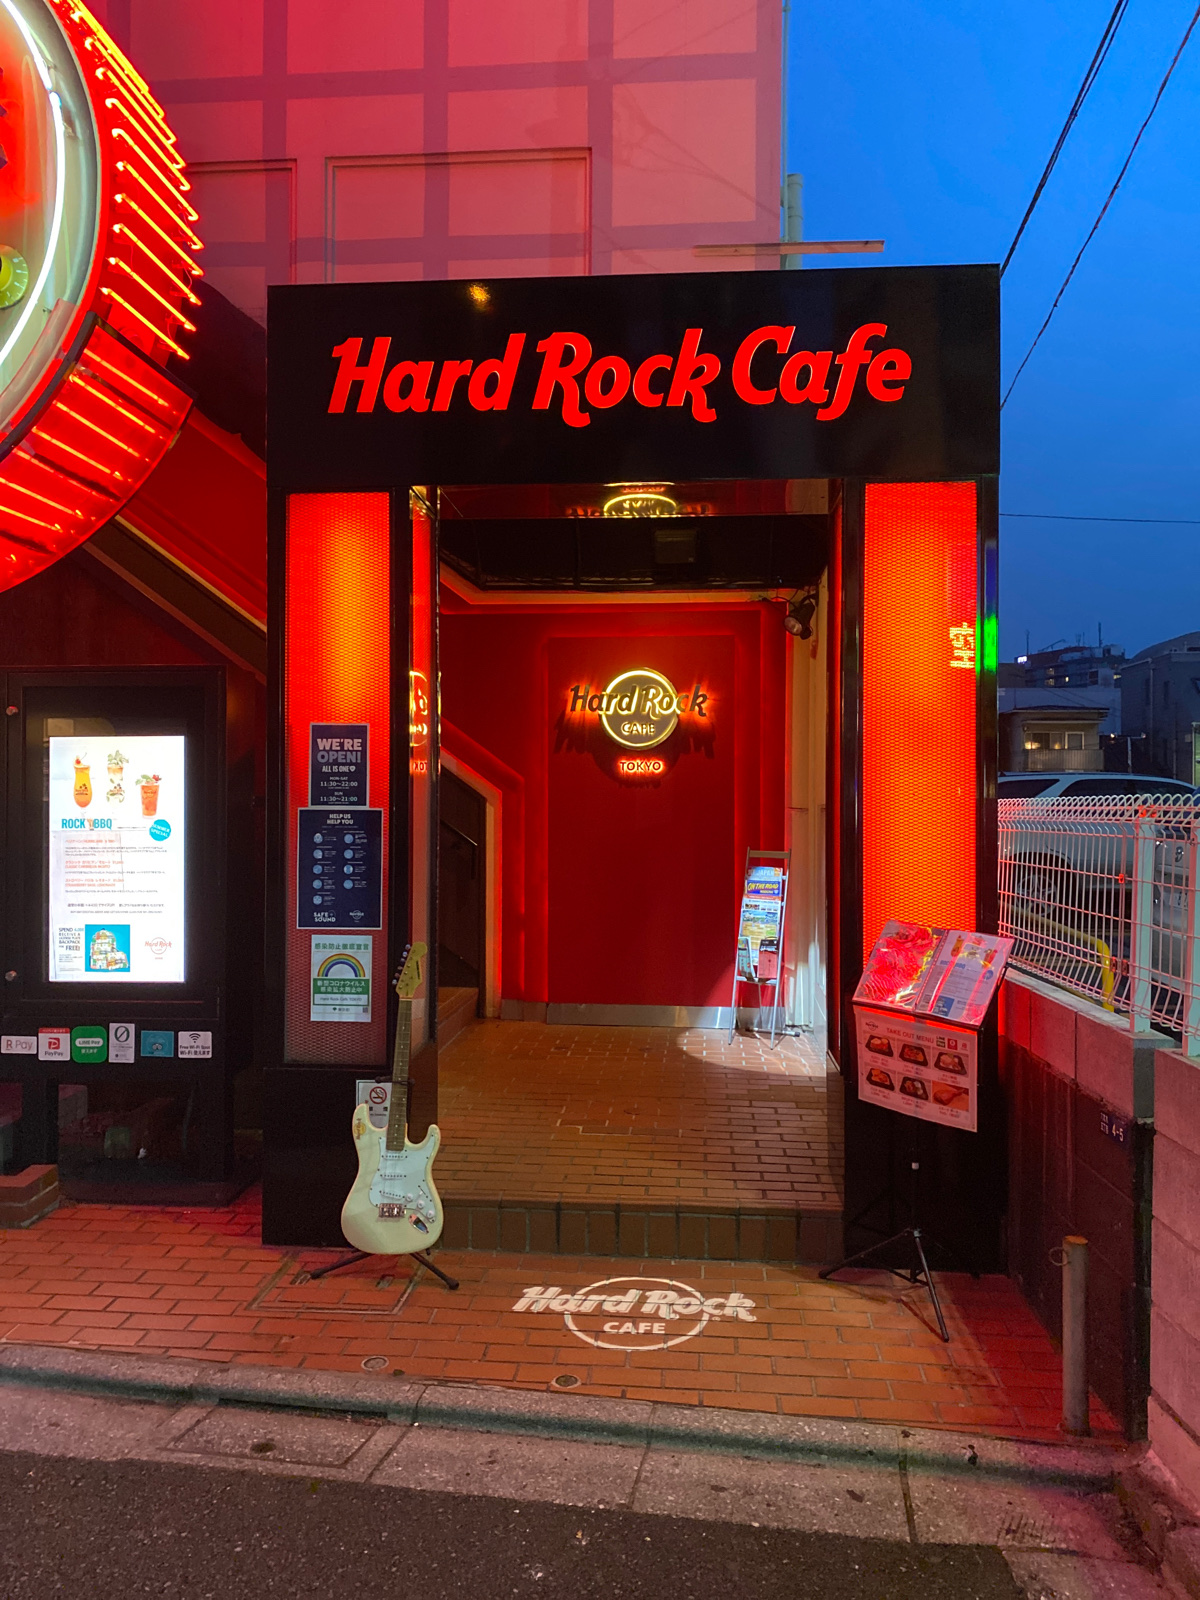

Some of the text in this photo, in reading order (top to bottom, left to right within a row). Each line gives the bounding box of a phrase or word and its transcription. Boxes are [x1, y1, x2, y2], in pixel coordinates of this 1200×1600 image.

[328, 323, 912, 427] Hard Rock Cafe
[570, 684, 708, 720] Hard Rock
[621, 721, 655, 736] CAFE
[317, 738, 362, 750] WE'RE
[317, 751, 361, 763] OPEN!
[619, 761, 663, 772] TOKYO
[61, 818, 112, 830] ROCK BBQ
[151, 829, 168, 837] SPECIAL
[886, 1028, 934, 1043] TAKE OUT MENU
[16, 1040, 33, 1051] Pay
[512, 1286, 757, 1322] Hard Rock
[603, 1322, 666, 1334] CAFE
